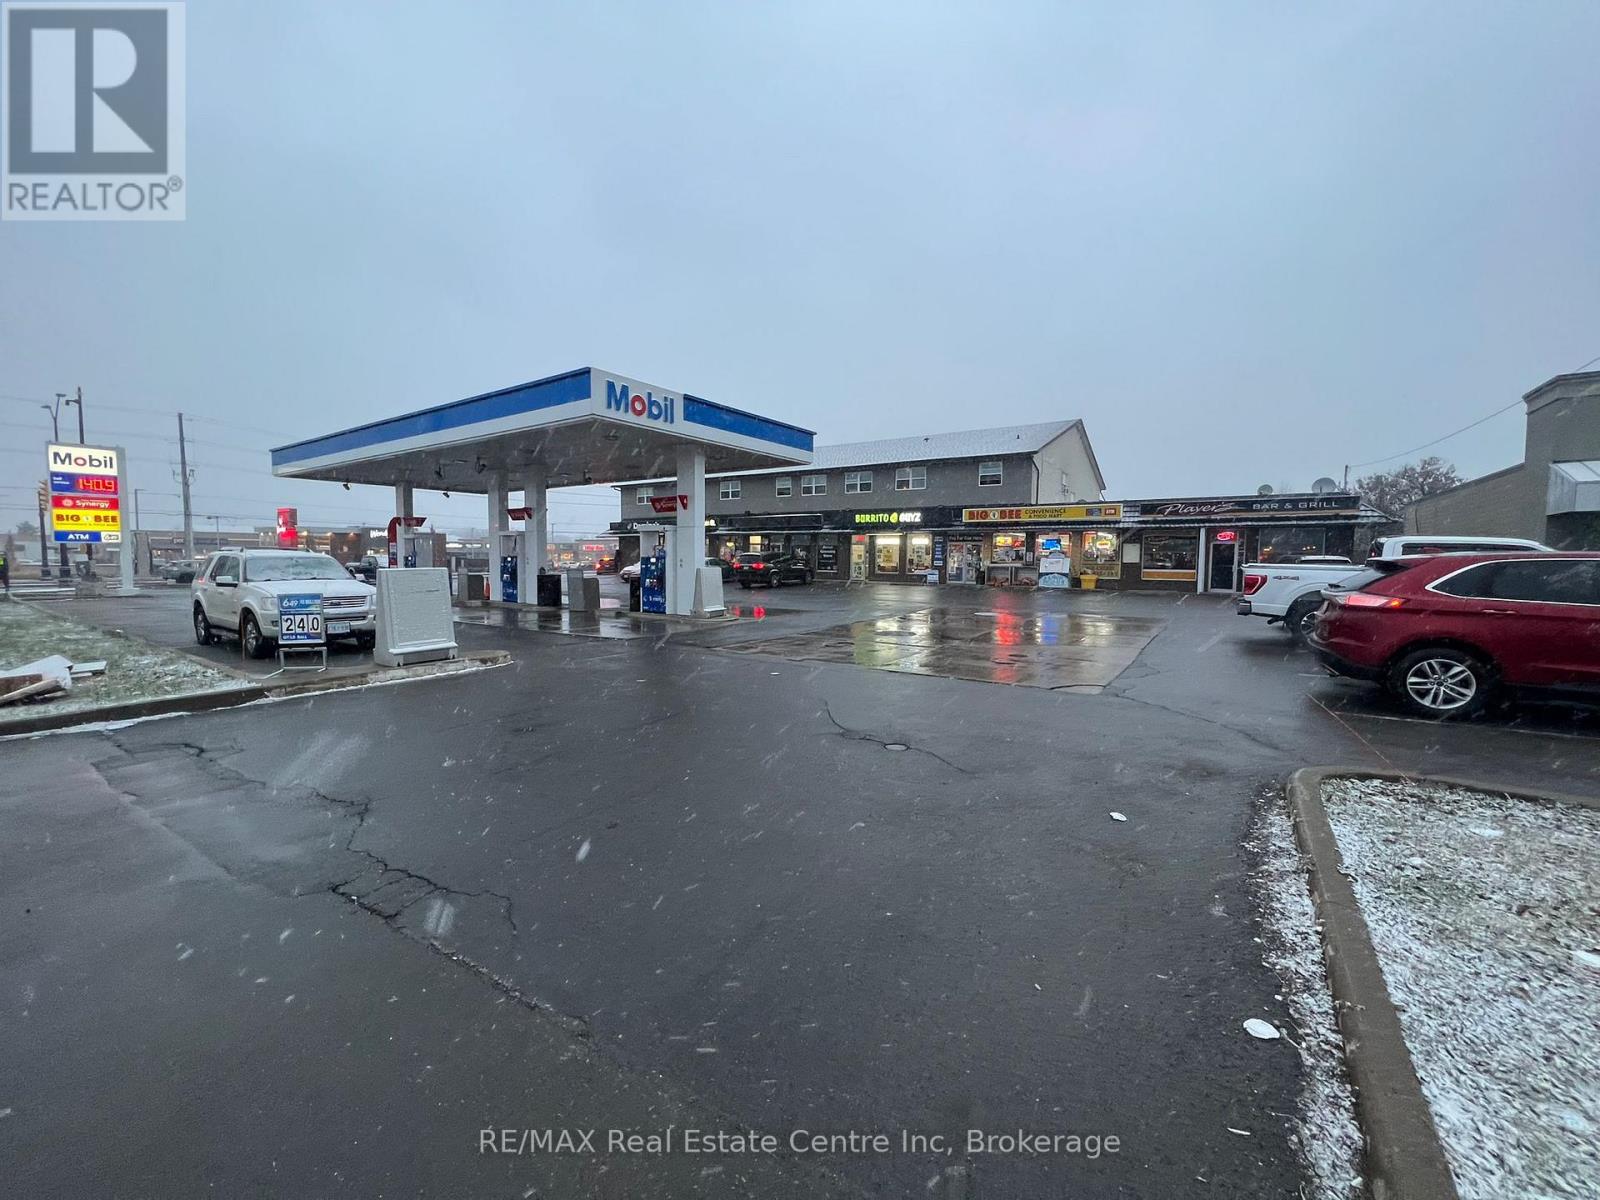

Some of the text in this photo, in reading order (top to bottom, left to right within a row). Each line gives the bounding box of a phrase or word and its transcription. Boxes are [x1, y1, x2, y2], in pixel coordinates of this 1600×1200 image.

[606, 379, 674, 424] Mobil
[53, 451, 113, 469] Mobil
[75, 500, 110, 508] Synergy
[1156, 502, 1235, 516] Player's
[1298, 501, 1340, 509] GRILL
[55, 513, 118, 523] BIG BEE
[855, 511, 921, 523] BURRITO GUYZ
[968, 509, 1022, 520] BIG BEE
